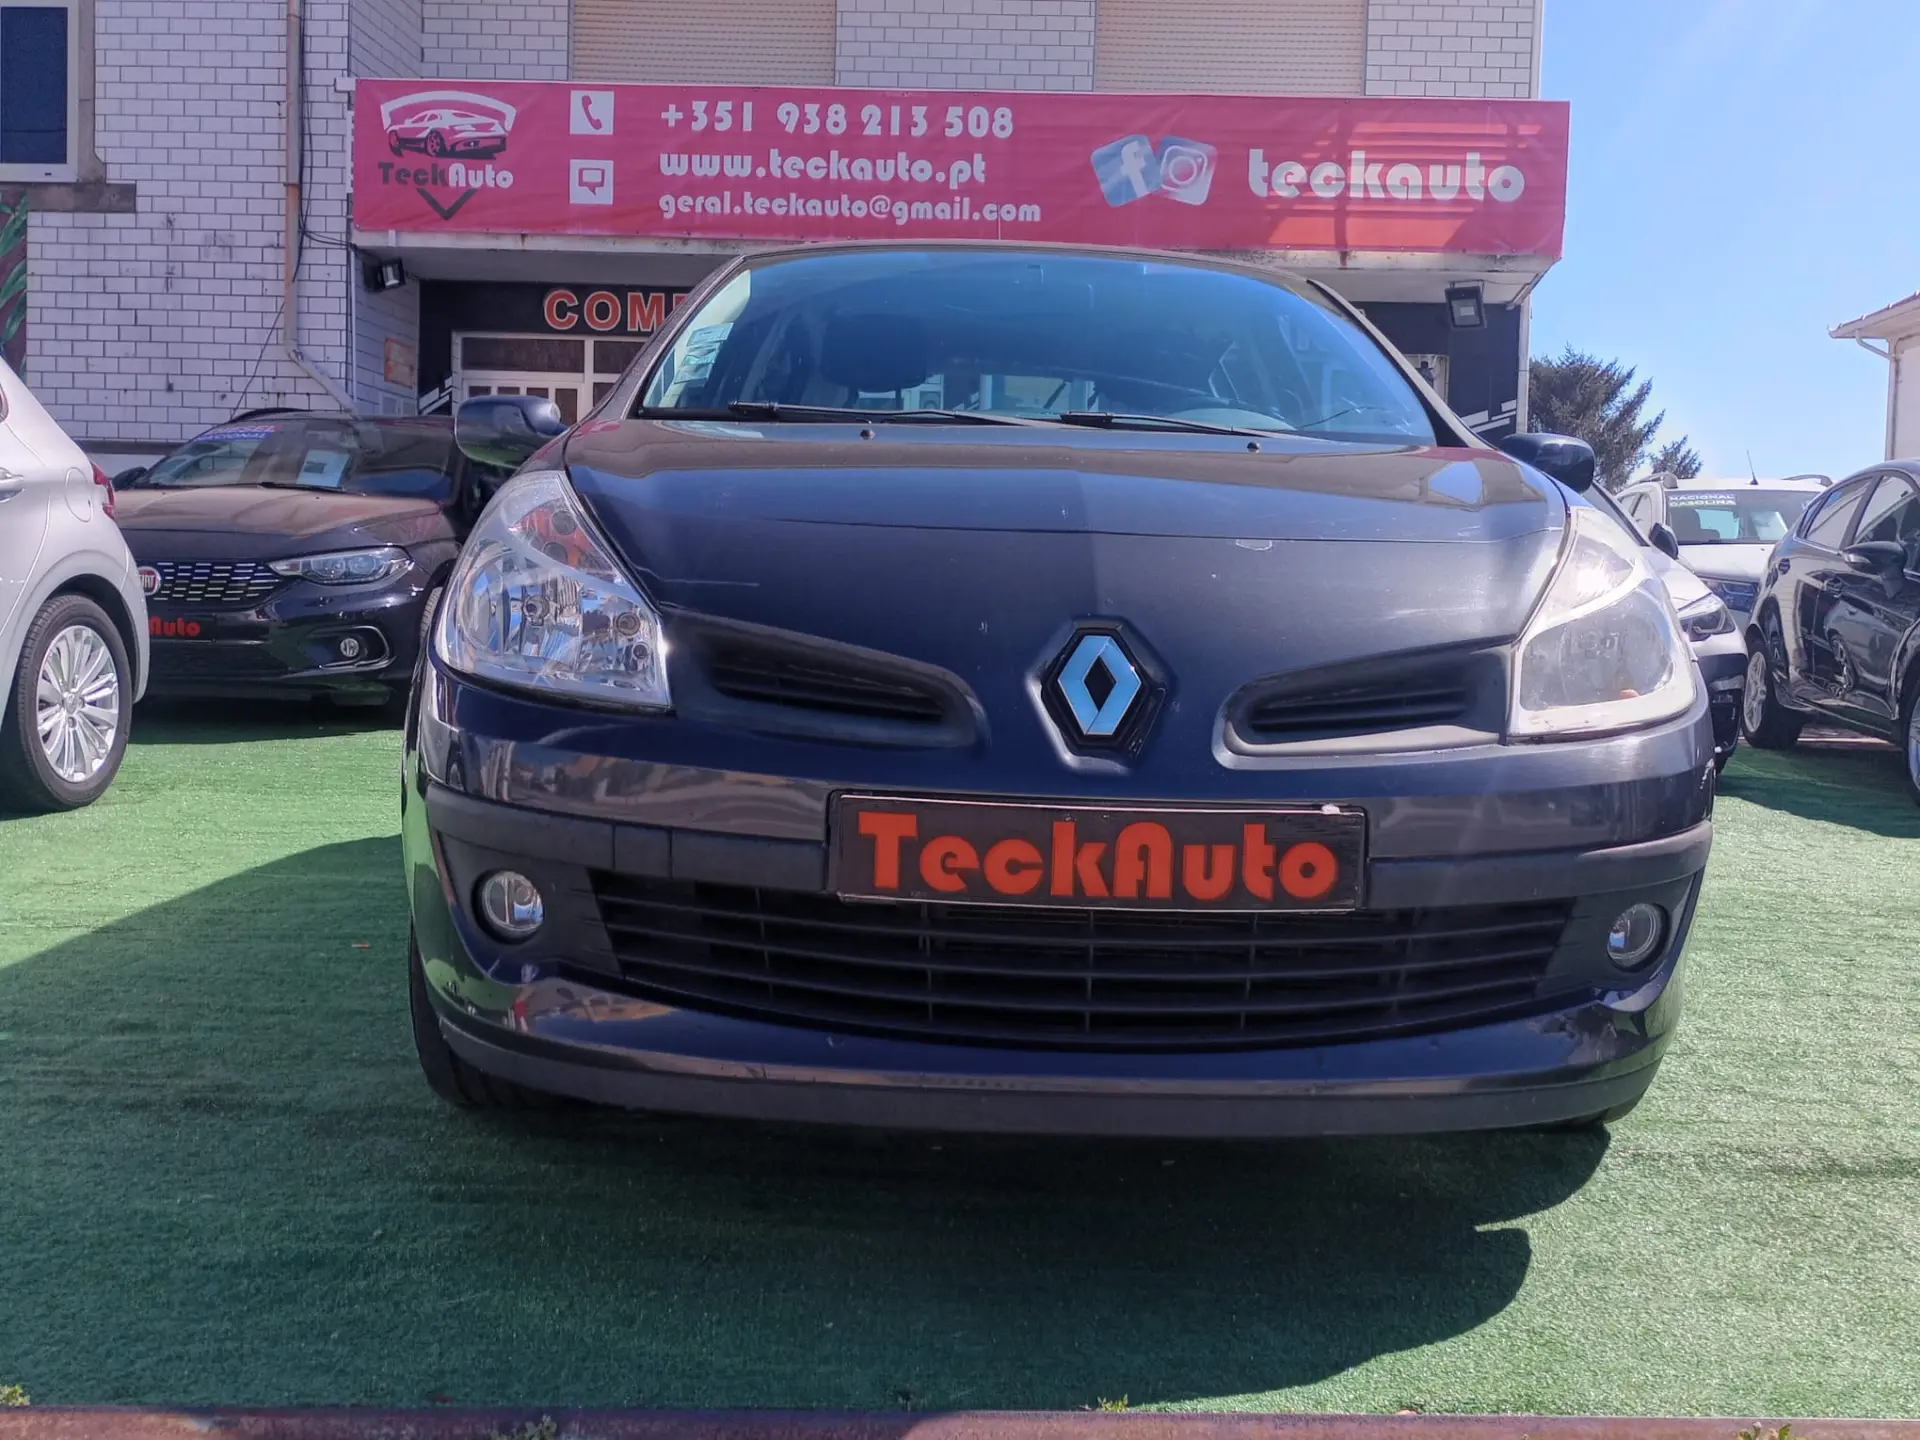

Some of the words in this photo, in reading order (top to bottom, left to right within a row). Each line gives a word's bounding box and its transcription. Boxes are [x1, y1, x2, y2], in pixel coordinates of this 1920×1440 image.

[660, 99, 753, 132] +351
[776, 102, 848, 135] 938
[860, 104, 928, 138] 213
[944, 106, 1014, 139] 508
[377, 161, 514, 189] TeckAuto
[659, 148, 986, 190] www.teckauto.pt
[1247, 148, 1525, 201] teckauto
[658, 191, 1042, 226] geral.teckauto@gmail.com
[544, 289, 688, 332] COM
[858, 810, 1339, 901] TeckAuto
